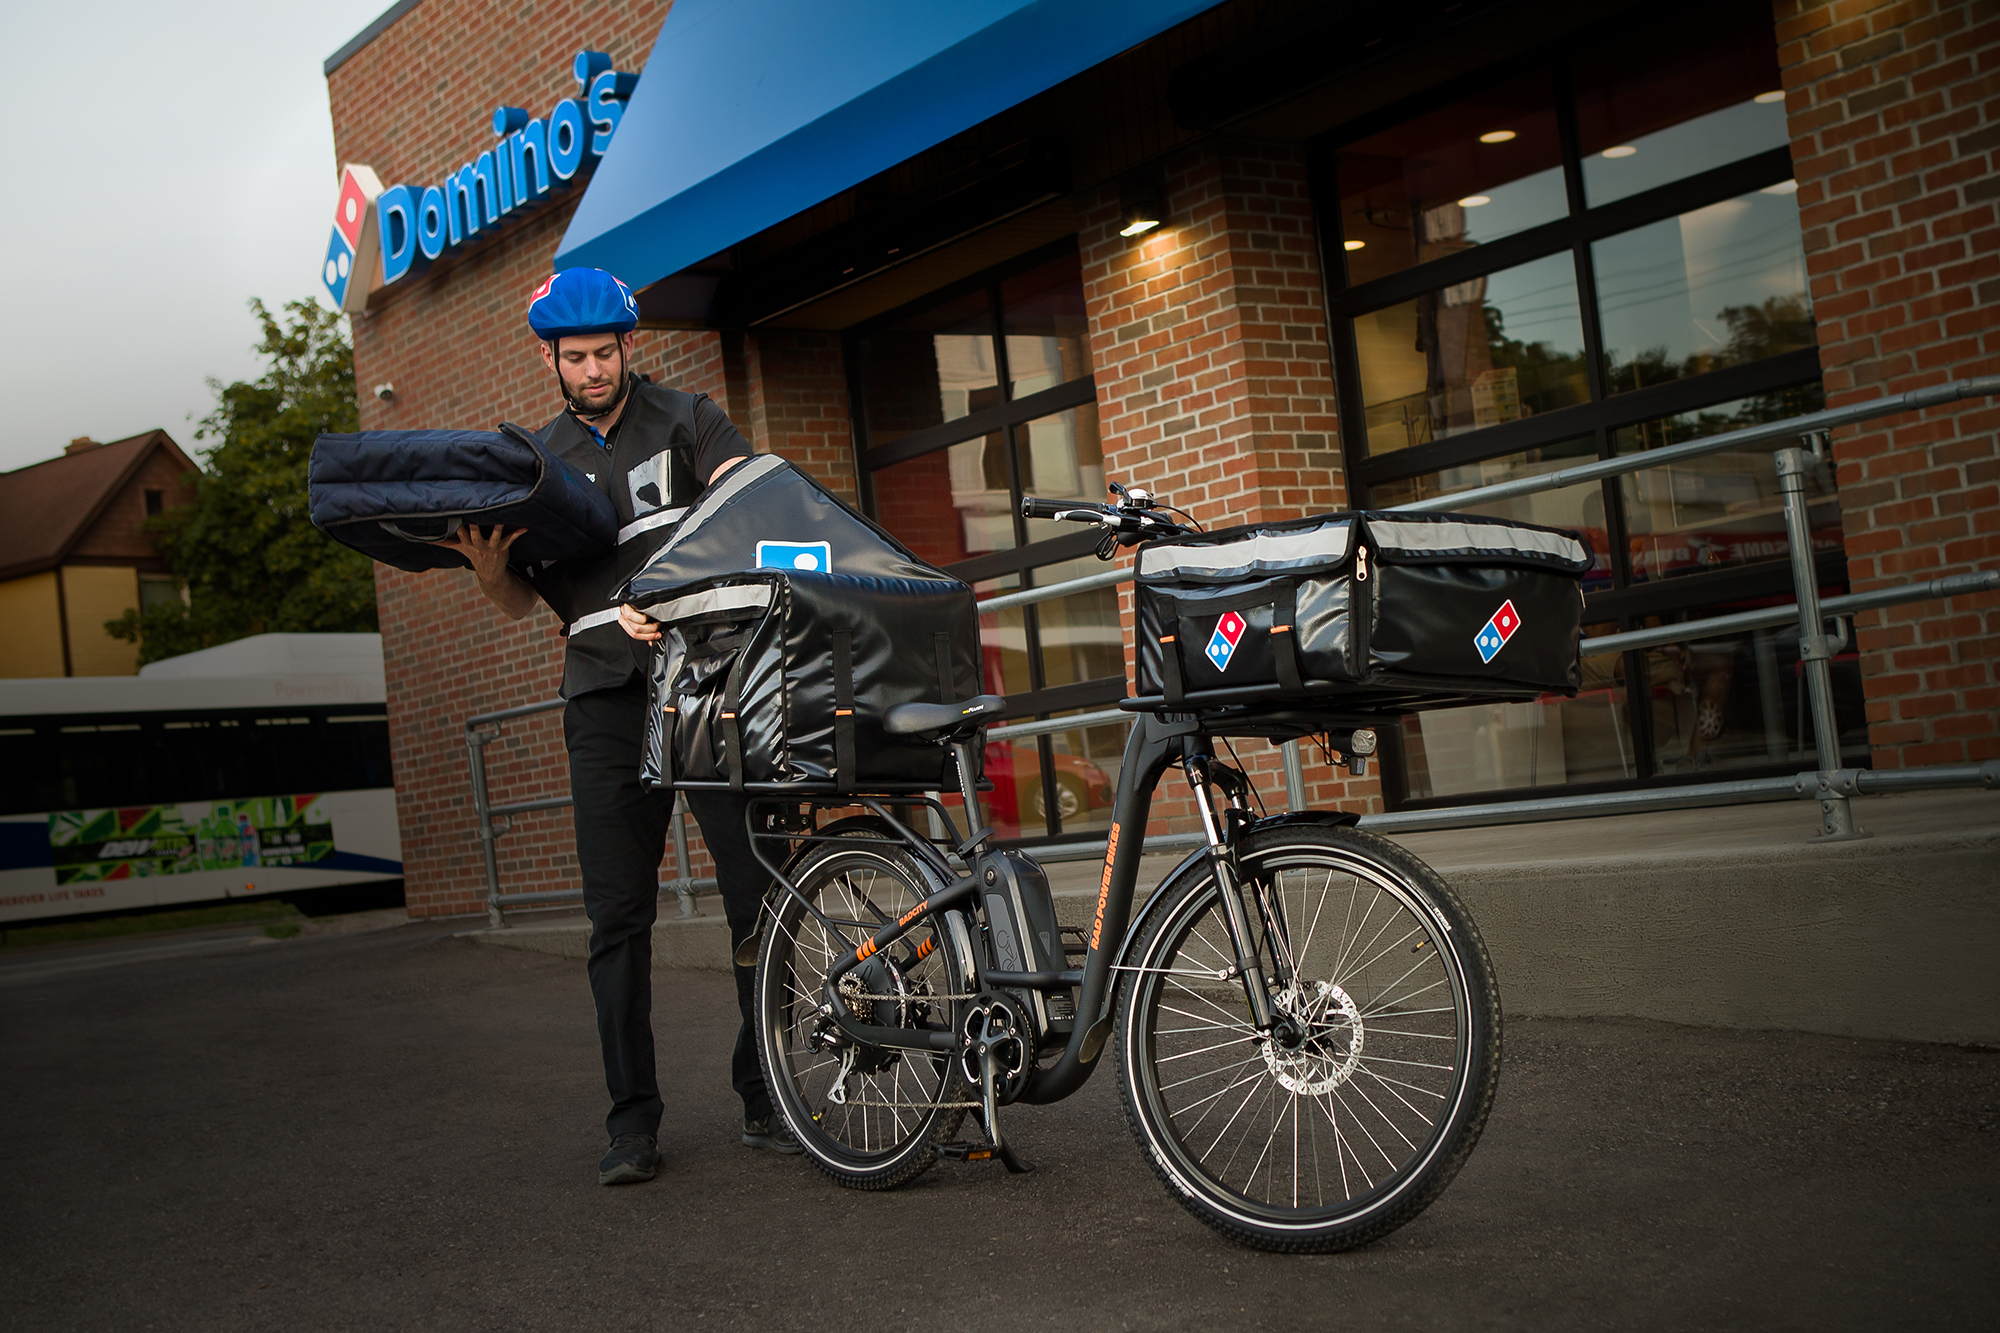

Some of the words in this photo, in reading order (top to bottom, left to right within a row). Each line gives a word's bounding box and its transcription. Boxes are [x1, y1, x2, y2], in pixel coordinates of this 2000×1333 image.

[377, 50, 630, 286] Domino's
[1106, 821, 1121, 866] BIKES
[899, 900, 928, 927] RADCITY
[1096, 864, 1113, 920] POWER
[1090, 918, 1103, 951] RAD
